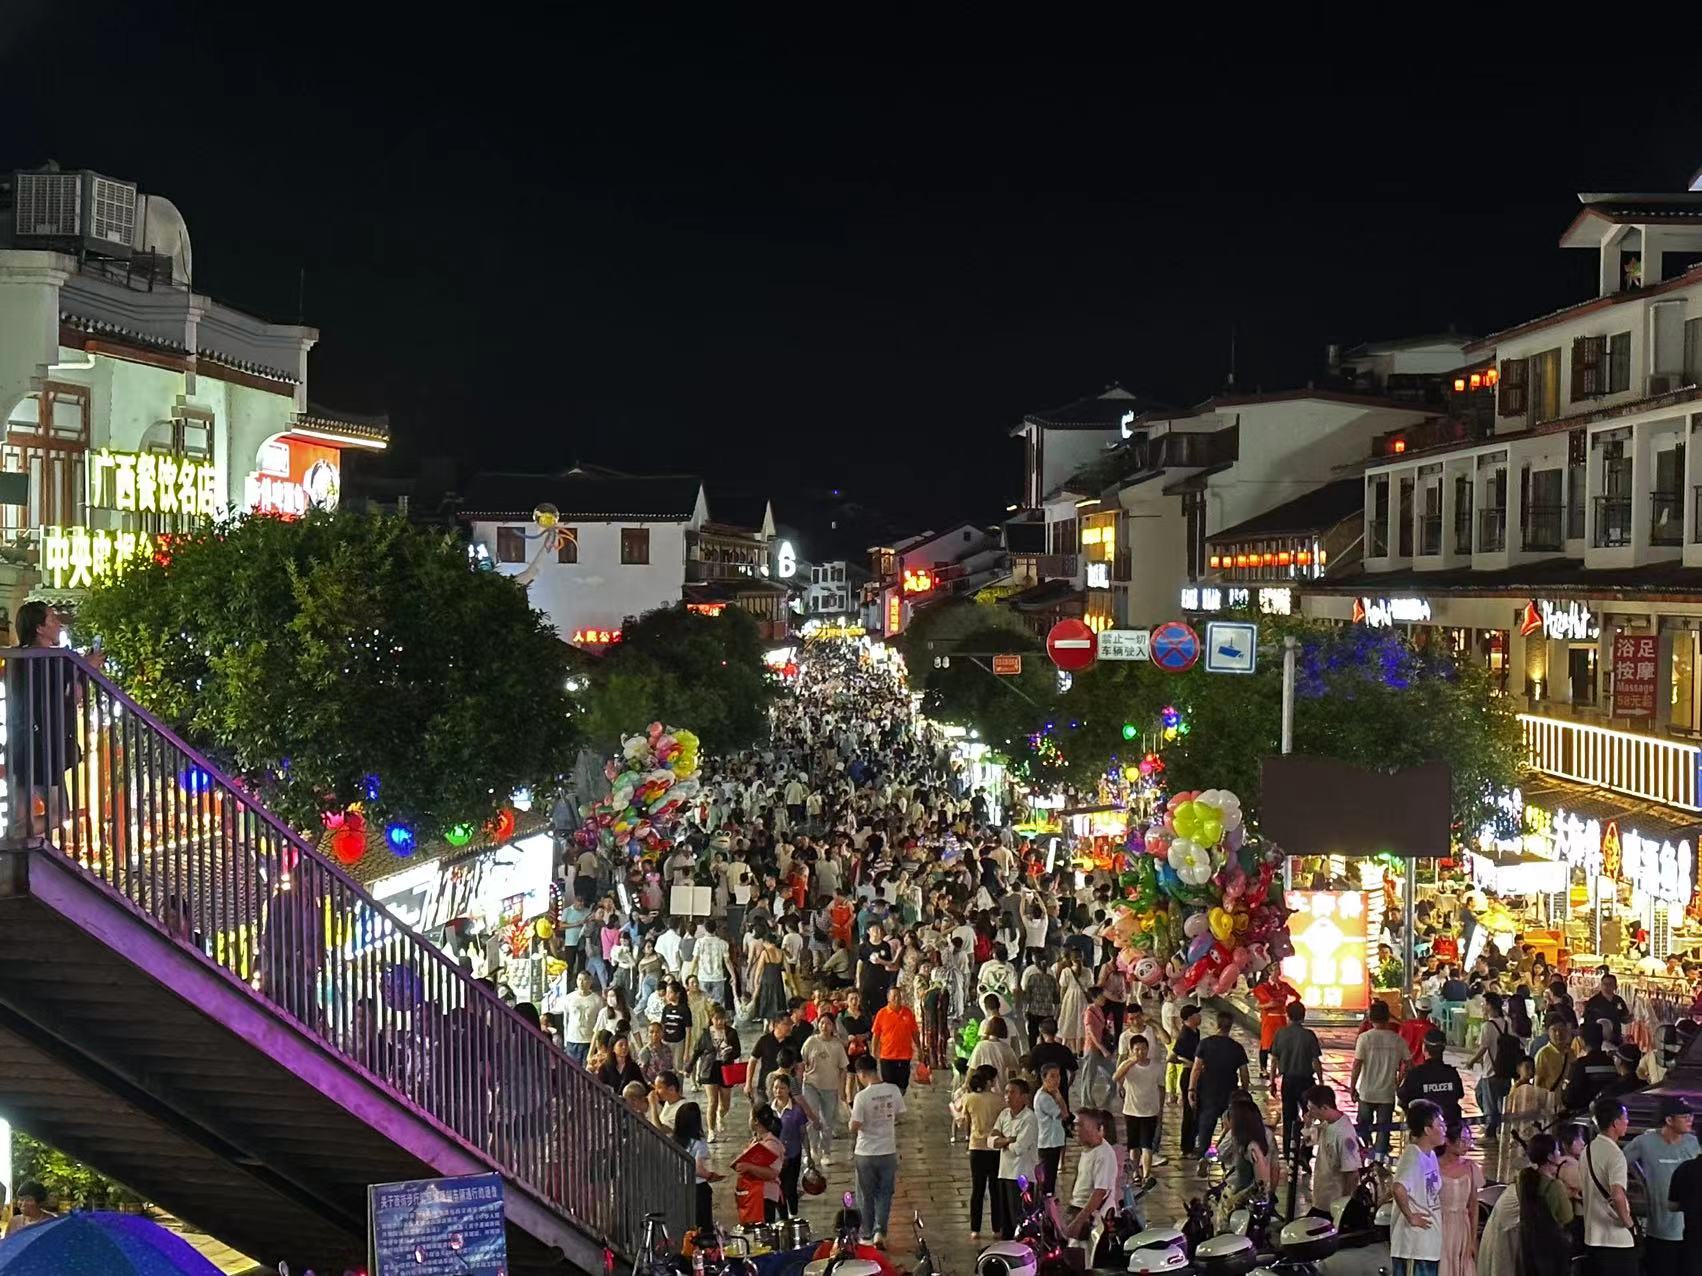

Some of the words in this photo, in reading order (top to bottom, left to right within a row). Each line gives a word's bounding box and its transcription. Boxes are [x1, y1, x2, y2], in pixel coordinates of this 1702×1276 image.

[93, 448, 217, 516] 广西餐饮名店
[1102, 633, 1147, 645] 禁止一切
[1102, 646, 1147, 658] 车辆驶入
[1616, 638, 1656, 658] 浴足
[1616, 660, 1656, 681] 按摩
[1616, 681, 1655, 694] Massage
[1428, 1083, 1448, 1092] POLICE
